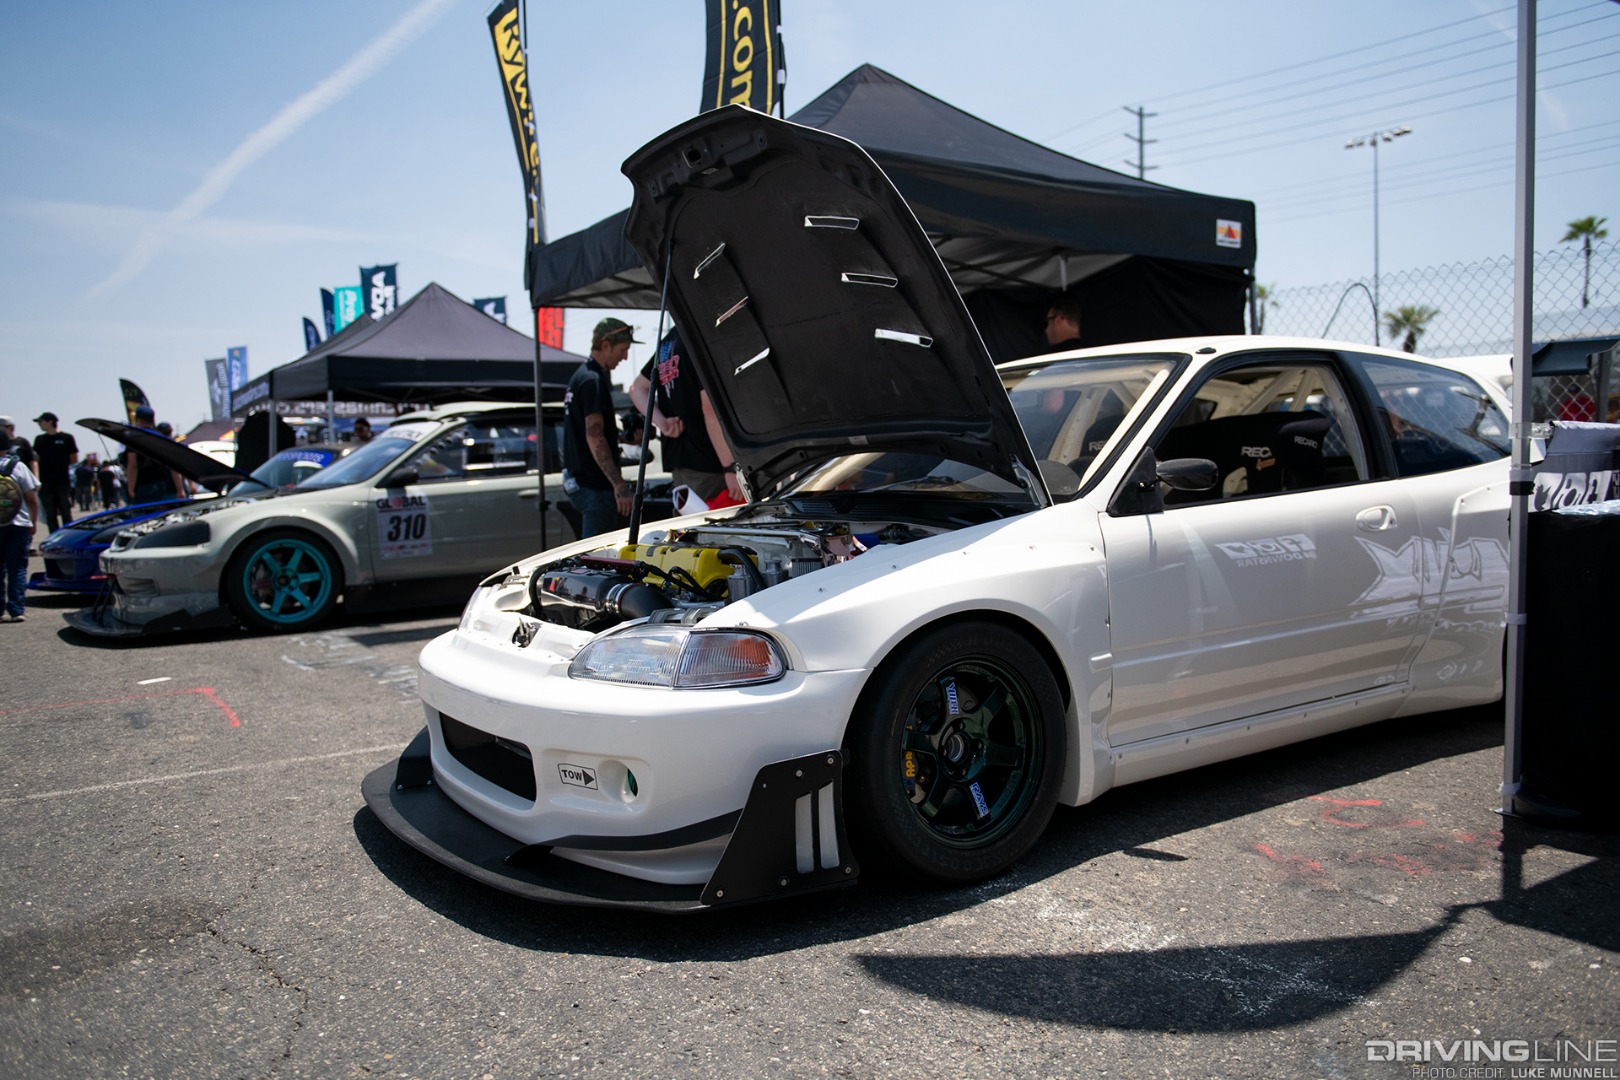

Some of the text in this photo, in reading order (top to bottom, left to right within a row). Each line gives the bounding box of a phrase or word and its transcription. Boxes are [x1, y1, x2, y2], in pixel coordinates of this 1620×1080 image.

[1294, 435, 1318, 449] RECARO
[387, 513, 427, 542] 310
[561, 769, 583, 781] TOW
